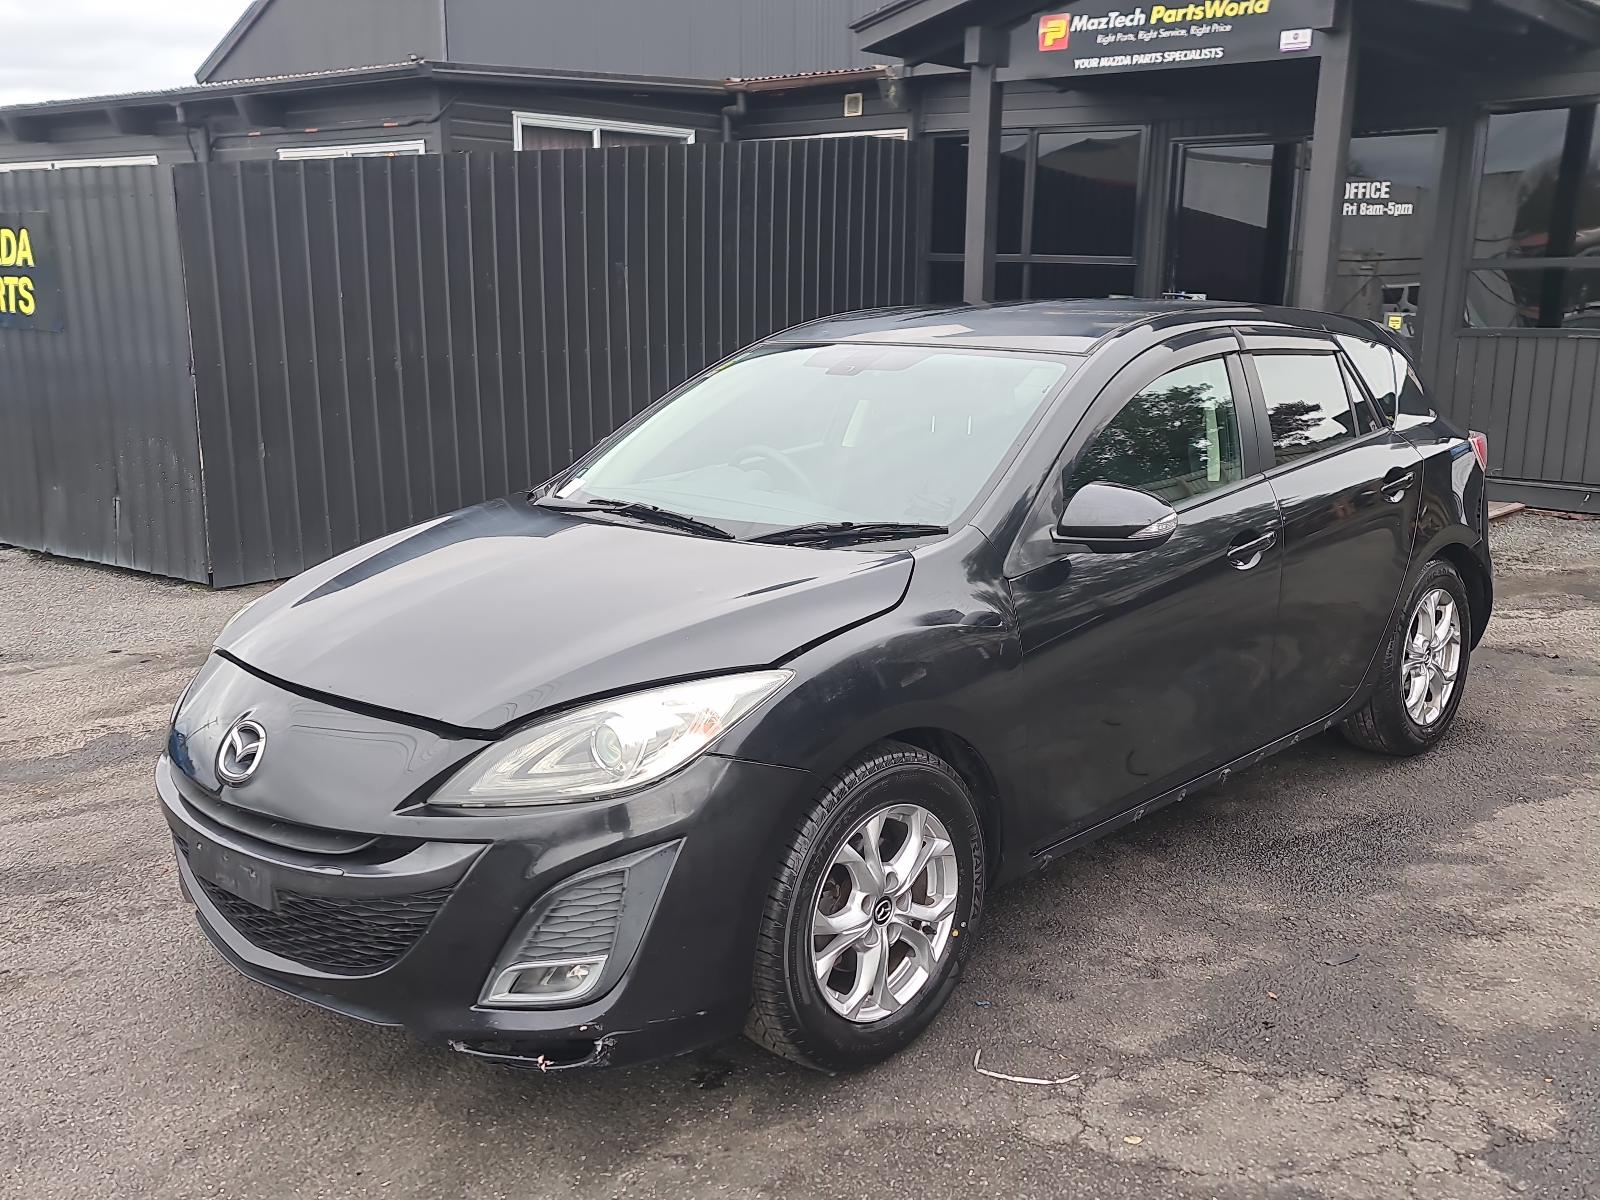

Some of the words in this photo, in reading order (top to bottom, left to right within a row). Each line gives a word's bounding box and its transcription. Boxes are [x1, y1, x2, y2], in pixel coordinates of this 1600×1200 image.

[1070, 8, 1146, 32] MazTech
[1149, 0, 1271, 25] PartsWorld
[1096, 33, 1115, 45] Right
[1116, 32, 1137, 42] Parts,
[1138, 29, 1158, 42] Right
[1158, 27, 1188, 39] Service,
[1189, 23, 1211, 37] Right
[1211, 22, 1233, 33] Price
[1074, 58, 1099, 70] YOUR
[1099, 55, 1131, 68] MAZDA
[1132, 52, 1163, 65] PARTS
[1163, 47, 1225, 62] SPECIALISTS
[1359, 201, 1414, 217] 8am-5pm
[0, 228, 34, 267] DA
